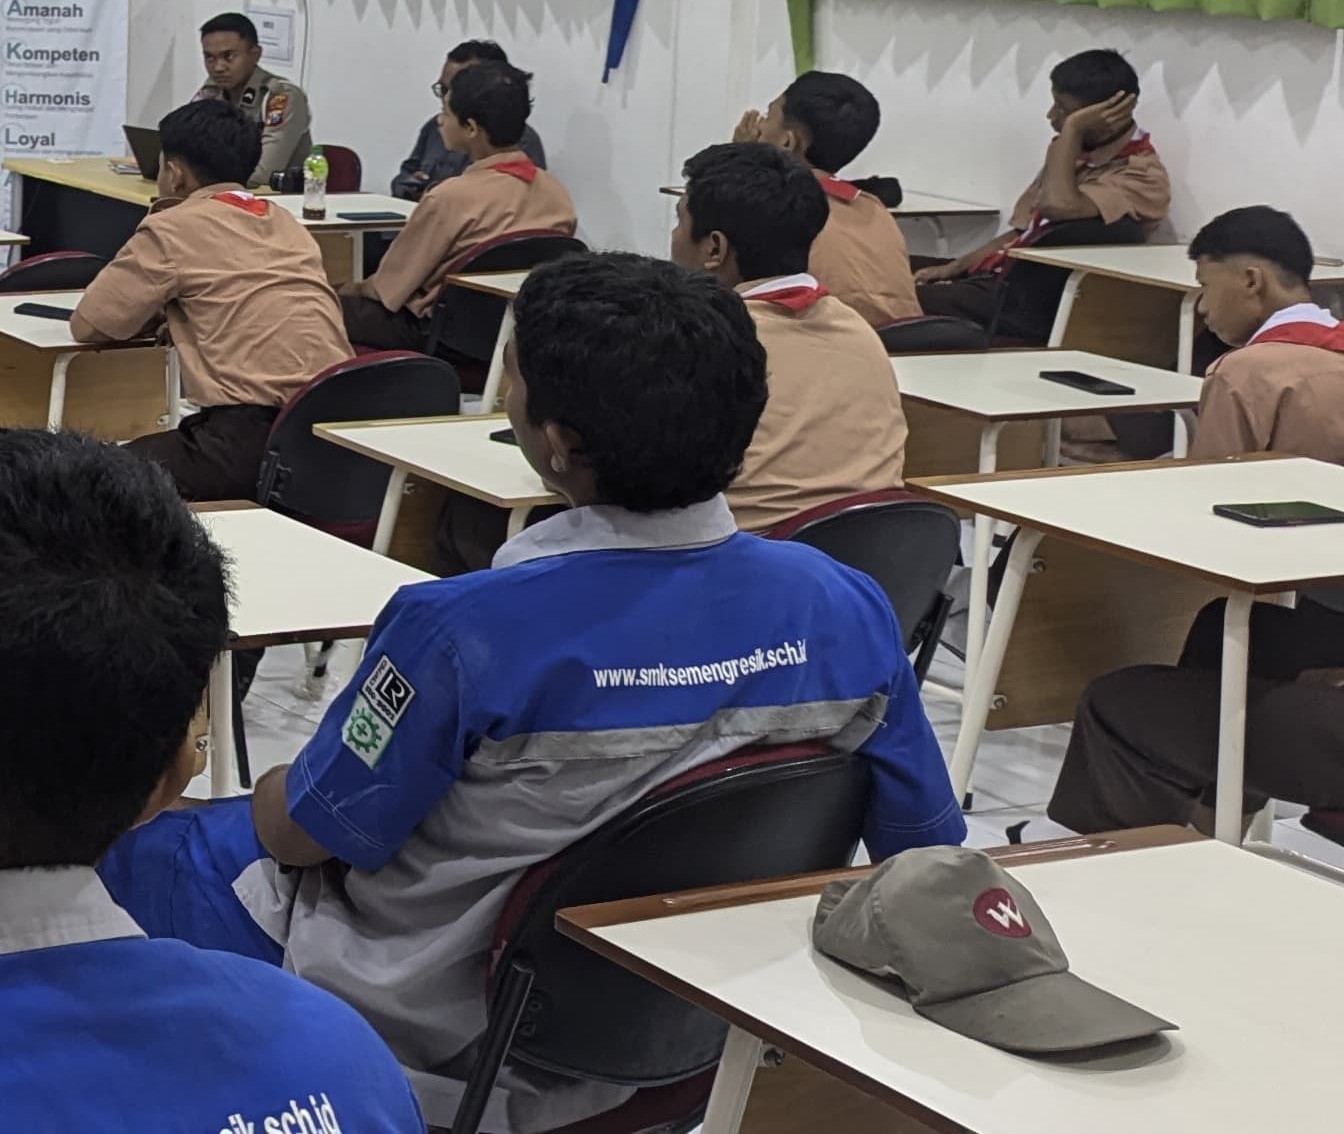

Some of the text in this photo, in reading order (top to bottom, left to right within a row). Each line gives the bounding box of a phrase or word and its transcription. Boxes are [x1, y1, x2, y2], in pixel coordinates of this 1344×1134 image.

[6, 42, 100, 65] Kompeten
[5, 89, 91, 106] Harmonis
[5, 127, 56, 149] Loyal
